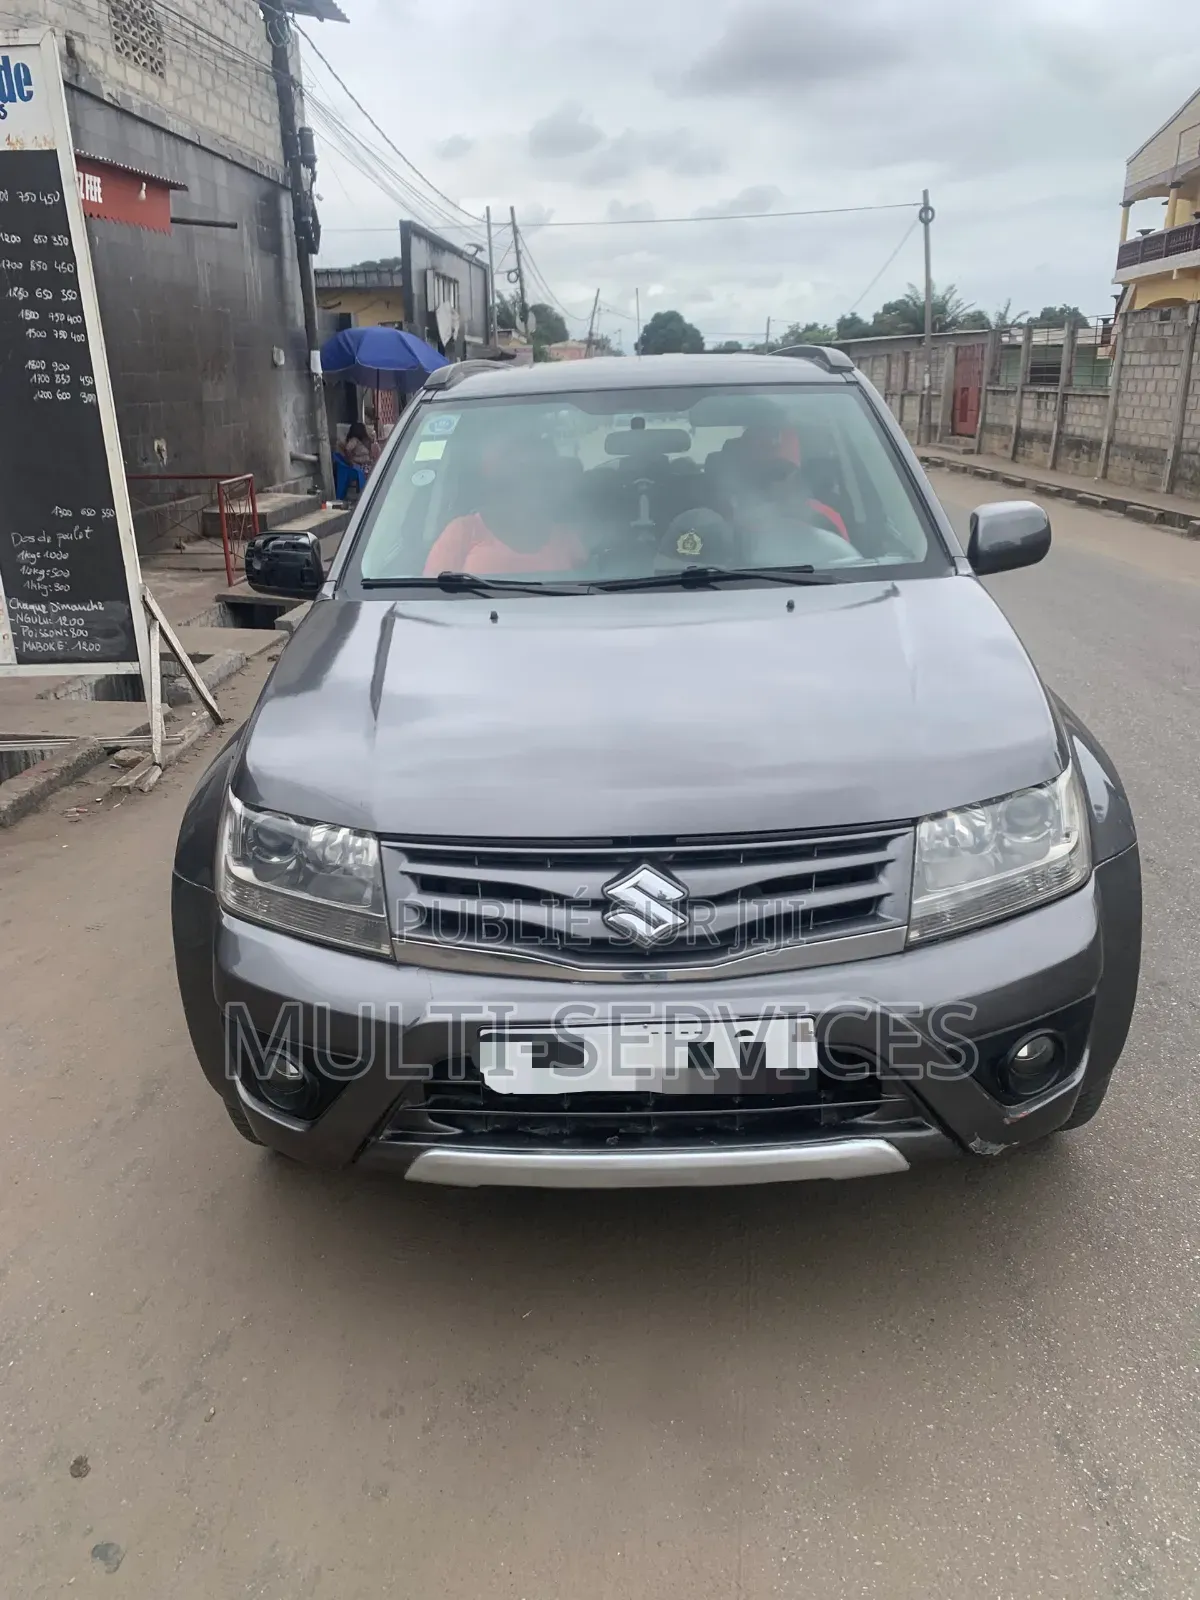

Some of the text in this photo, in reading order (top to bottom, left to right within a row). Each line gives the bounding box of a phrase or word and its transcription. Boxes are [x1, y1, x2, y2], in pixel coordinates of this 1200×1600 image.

[39, 190, 61, 205] 450
[33, 234, 48, 244] 650
[51, 235, 69, 246] 350
[35, 288, 53, 300] 650
[60, 288, 78, 301] 350
[66, 314, 83, 325] 400
[70, 332, 86, 343] 400
[51, 361, 70, 372] 900
[56, 389, 71, 401] 600
[54, 615, 85, 627] 1200
[71, 639, 101, 652] 1200
